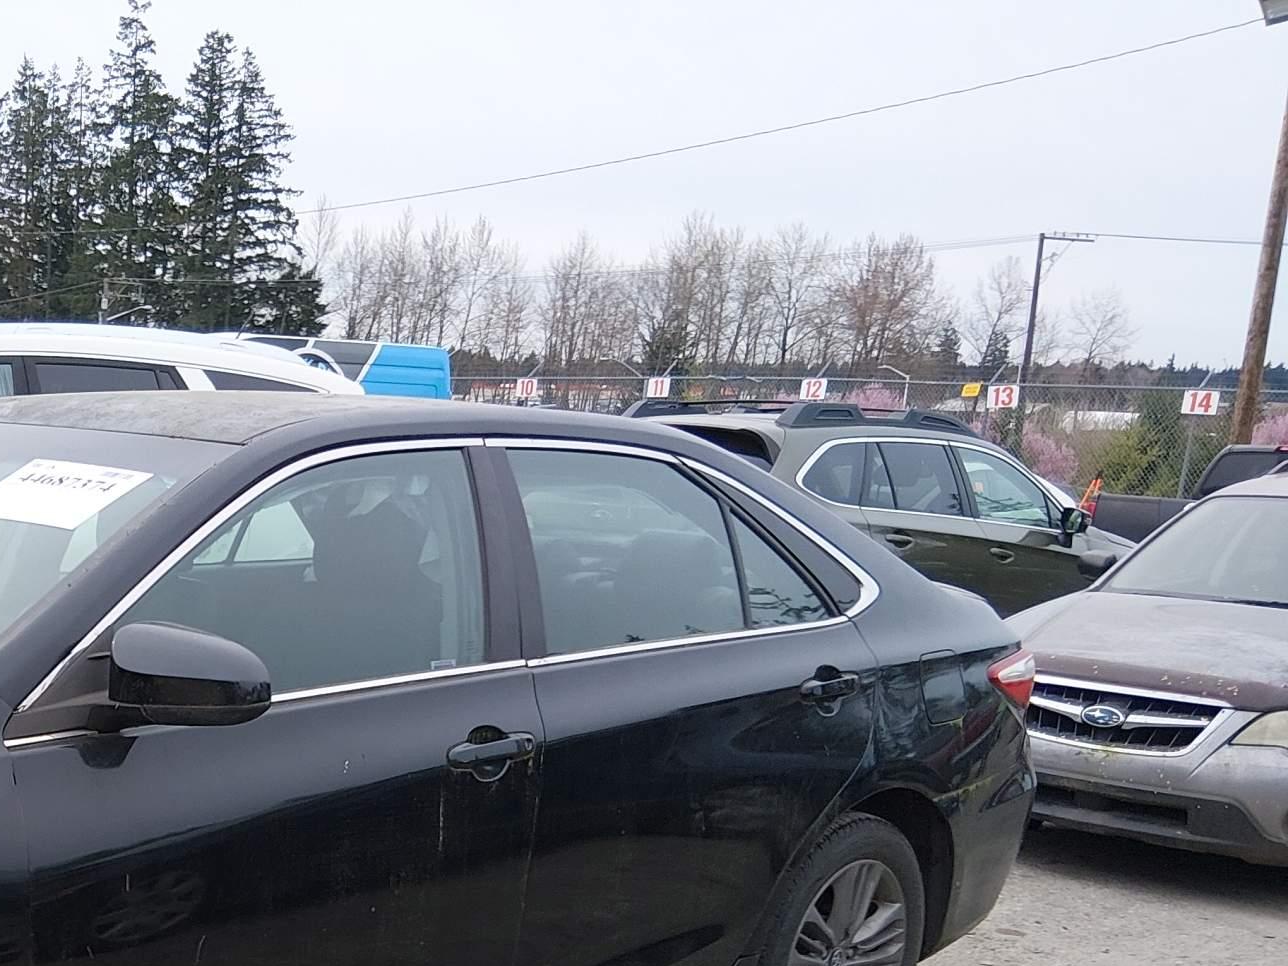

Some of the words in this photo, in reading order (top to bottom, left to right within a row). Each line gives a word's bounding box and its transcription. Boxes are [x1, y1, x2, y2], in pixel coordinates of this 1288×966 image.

[520, 379, 534, 396] 10
[653, 379, 665, 396] 11
[805, 380, 823, 398] 12
[993, 386, 1015, 407] 13
[1189, 391, 1213, 413] 14
